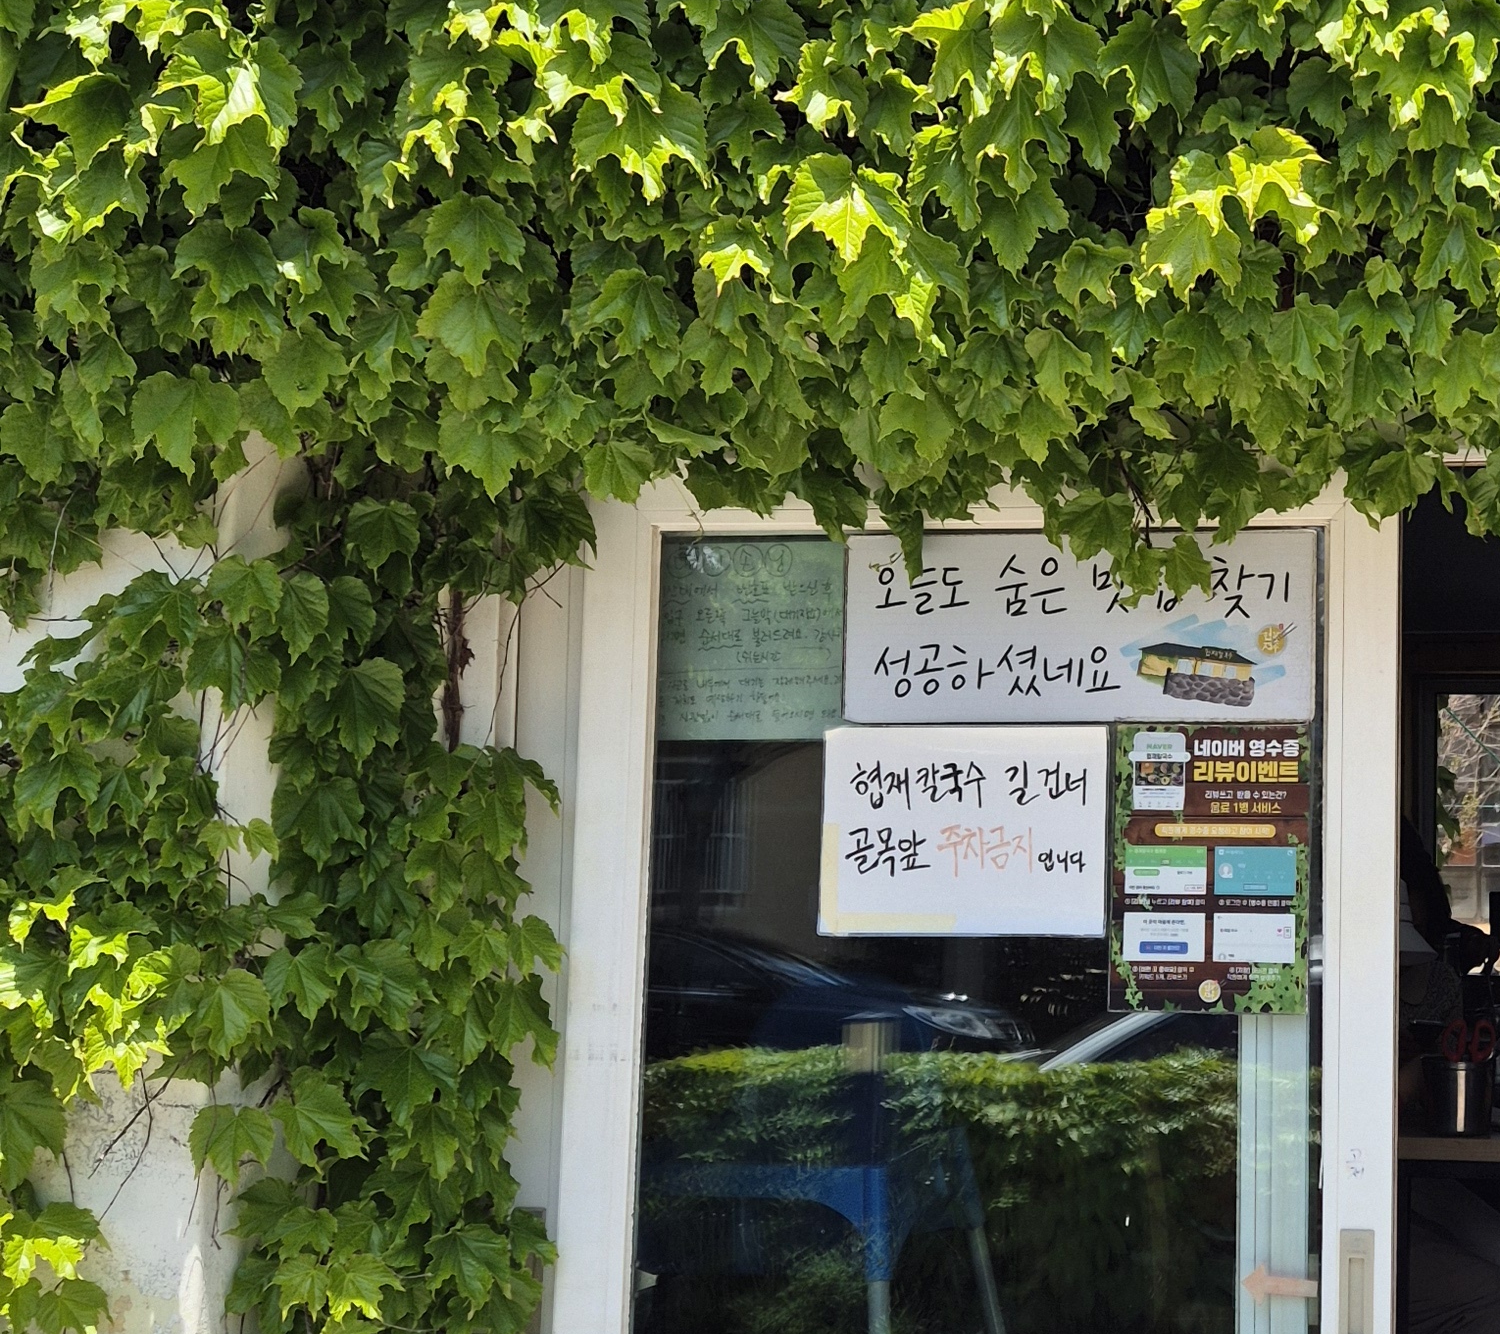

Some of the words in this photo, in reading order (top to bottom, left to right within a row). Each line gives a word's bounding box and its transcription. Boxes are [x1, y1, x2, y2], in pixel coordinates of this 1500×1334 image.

[875, 566, 970, 615] 오늘도
[995, 554, 1068, 616] 숨은
[1211, 556, 1290, 618] 찾기
[698, 627, 743, 645] 순서대로
[874, 644, 1121, 698] 성공하셨네요
[1193, 739, 1245, 757] 네이버
[1249, 739, 1300, 757] 영수증
[1193, 760, 1299, 783] 리뷰이벤트
[850, 760, 987, 810] 협재칼국수
[1204, 790, 1234, 799] 리뷰쓰고
[1252, 791, 1261, 799] 수
[1210, 801, 1230, 814] 음료
[1233, 801, 1249, 814] 1병
[1251, 801, 1282, 814] 서비스
[845, 827, 931, 877] 골목앞
[936, 824, 1033, 878] 주차금지
[1037, 848, 1087, 873] 입니다
